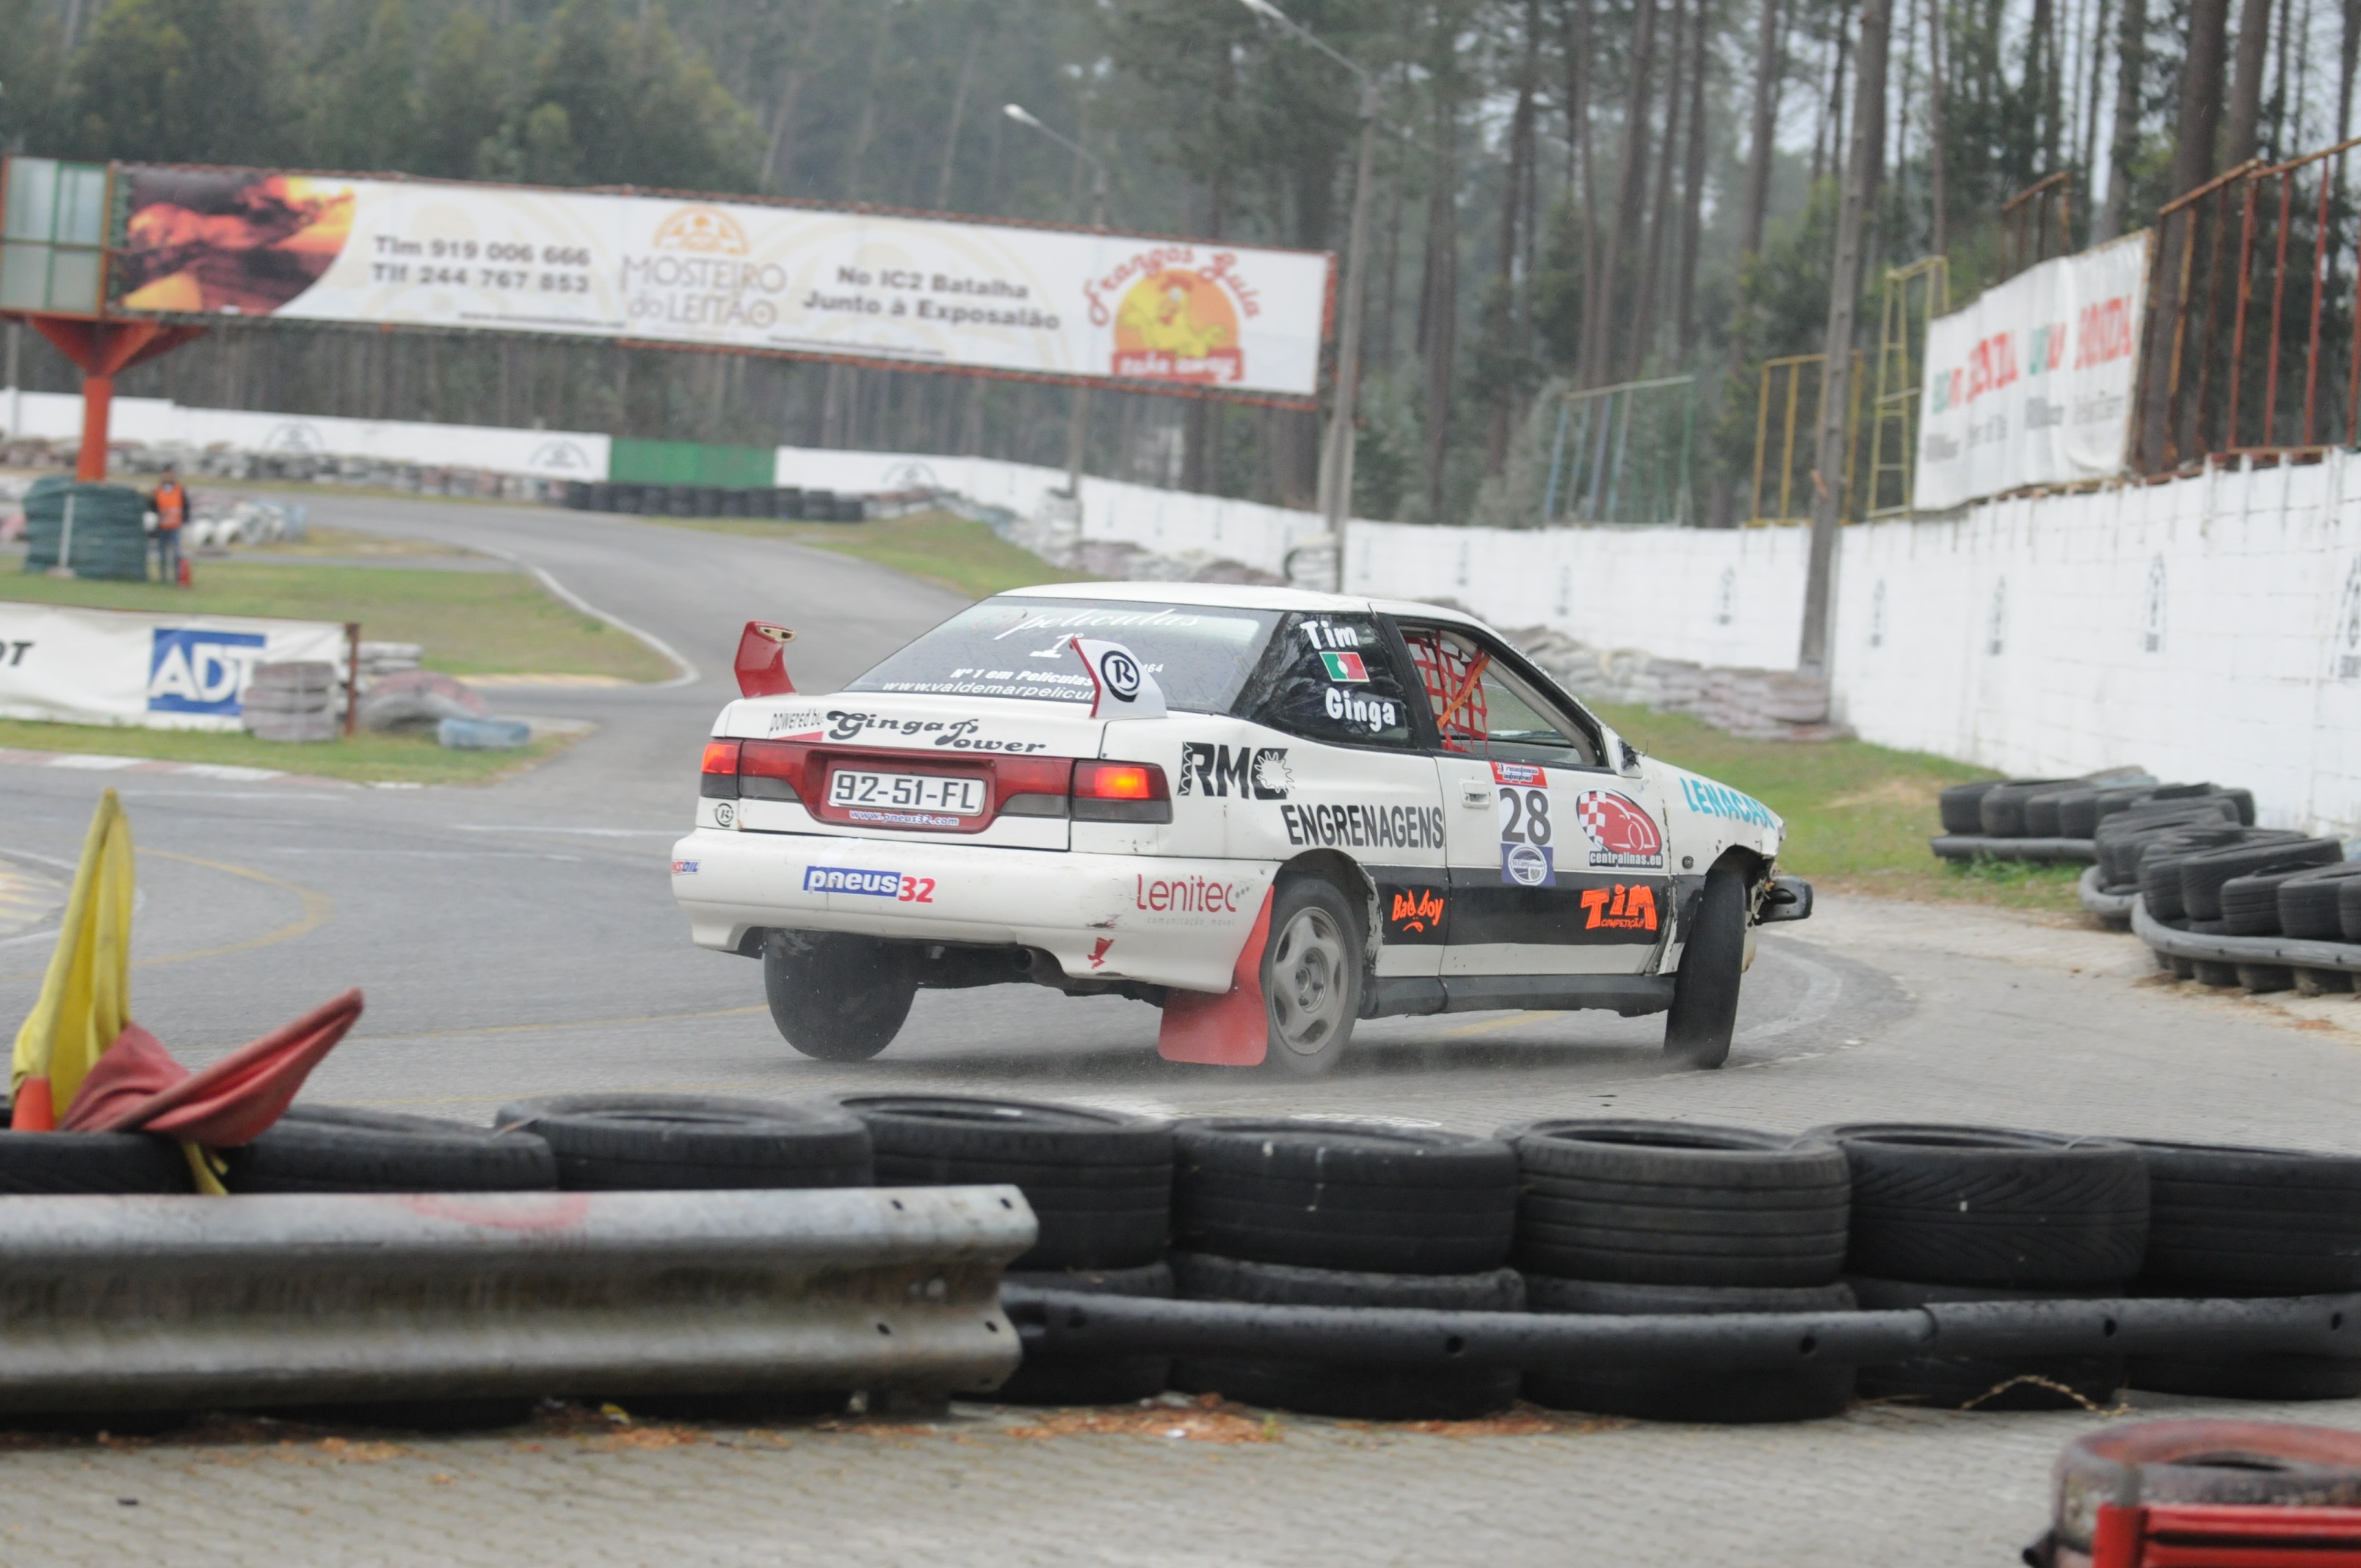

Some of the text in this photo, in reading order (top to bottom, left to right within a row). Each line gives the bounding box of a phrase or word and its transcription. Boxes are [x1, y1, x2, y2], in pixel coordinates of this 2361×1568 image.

[419, 266, 468, 285] 244
[480, 270, 529, 288] 767
[620, 255, 788, 294] MOSTEIRO
[880, 269, 924, 291] IC2
[932, 272, 1031, 300] Batalha
[802, 290, 881, 314] Junto
[916, 298, 1062, 330] Exposalão
[1299, 620, 1359, 650] Tim
[148, 642, 267, 705] ADT
[985, 669, 1015, 680] em
[1325, 686, 1396, 733] Ginga
[826, 710, 1046, 753] Ginga Power
[1177, 741, 1295, 801] RMC
[835, 774, 976, 810] 92-51-FL
[850, 810, 960, 826] www.pneus32.com
[1280, 804, 1446, 849] ENGRENAGENS
[1499, 788, 1551, 846] 28
[1589, 851, 1662, 866] centralinas.eu
[808, 870, 937, 904] pneus32
[1136, 874, 1237, 912] Lenitec
[1391, 888, 1445, 926] Bad boy
